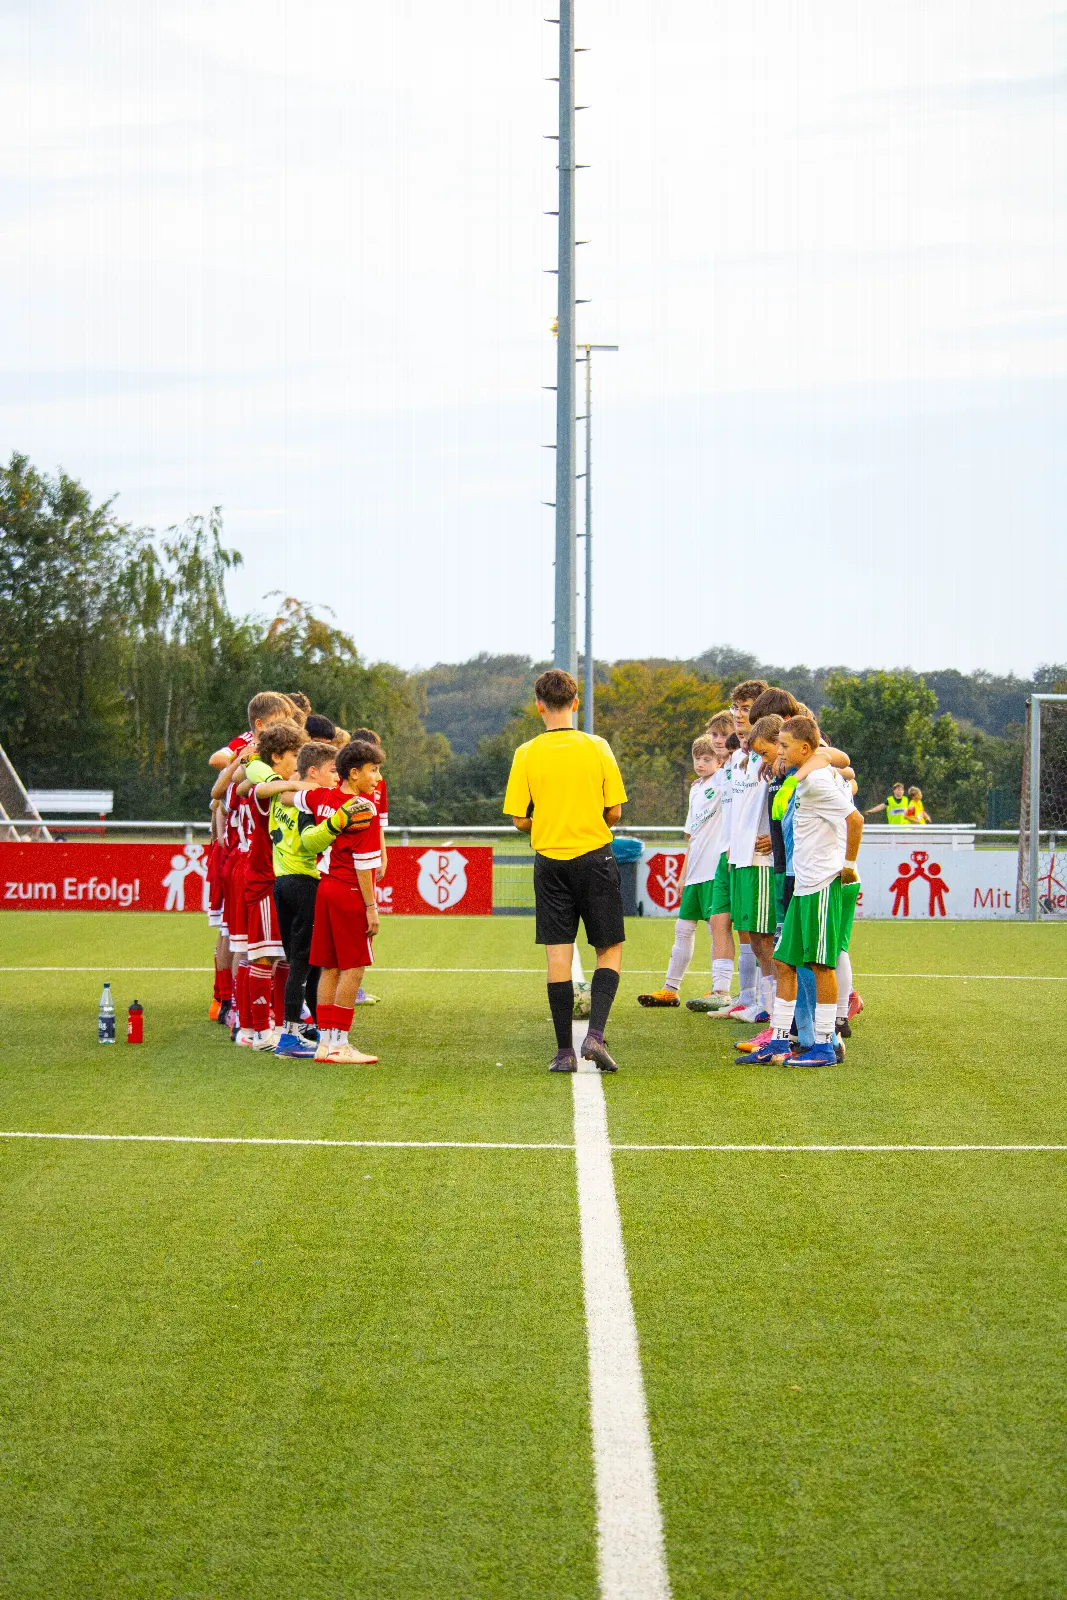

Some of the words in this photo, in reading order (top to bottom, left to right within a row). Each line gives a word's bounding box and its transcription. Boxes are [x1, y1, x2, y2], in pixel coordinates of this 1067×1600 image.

[4, 881, 57, 900] zum
[63, 876, 140, 907] Erfolg!
[974, 887, 1012, 909] Mit
